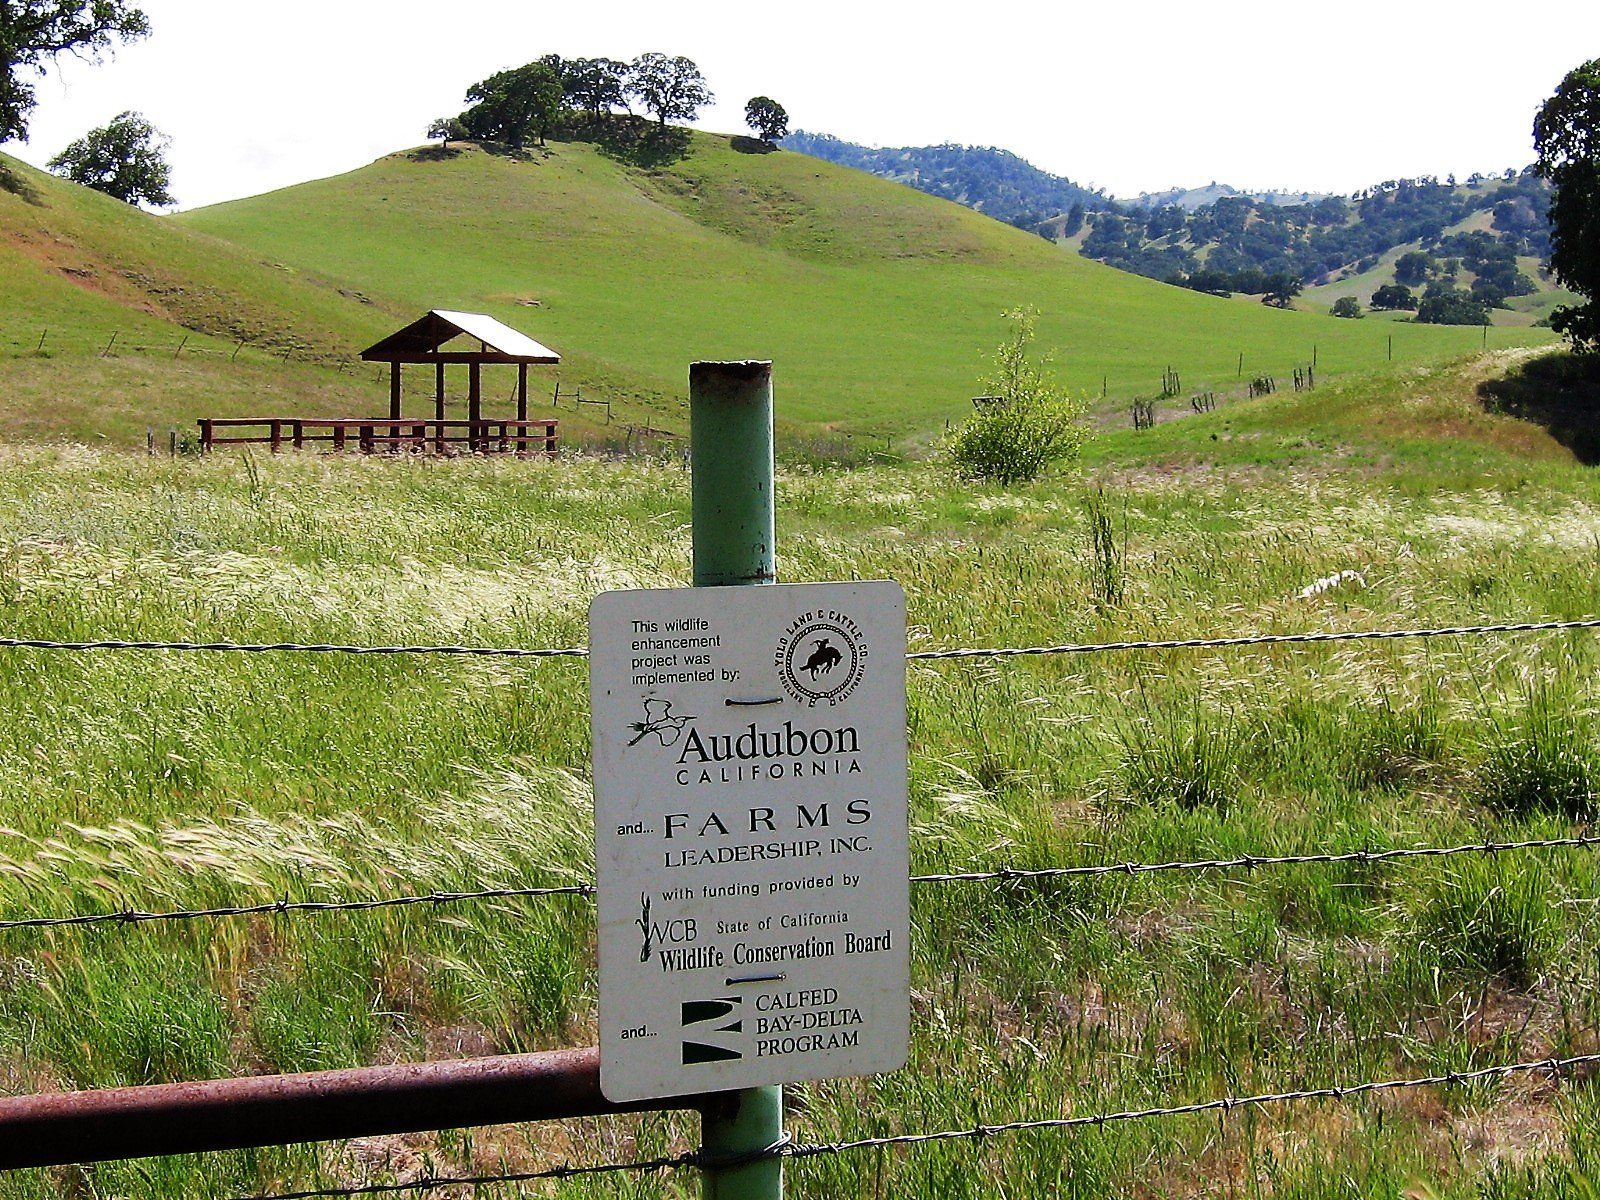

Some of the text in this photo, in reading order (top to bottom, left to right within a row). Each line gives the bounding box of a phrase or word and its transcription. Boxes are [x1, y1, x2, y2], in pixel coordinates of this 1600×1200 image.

[631, 619, 709, 633] This wildlife
[775, 638, 787, 666] YOLO
[786, 612, 813, 635] LAND
[829, 610, 863, 640] CATTLE
[631, 636, 720, 650] enhancement
[631, 654, 711, 669] project was
[631, 668, 740, 686] implemented by:
[839, 664, 865, 702] CALIFORNIA
[676, 721, 860, 764] Audubon
[677, 759, 861, 785] CALIFORNIA
[617, 799, 872, 839] and... FARMS
[664, 836, 872, 868] LEADERSHIP, INC.
[662, 873, 860, 901] with funding provided by
[635, 911, 848, 944] WCB State of California
[659, 930, 891, 972] Wildlife Conservation Board
[756, 987, 838, 1011] CALFED
[621, 1025, 657, 1039] and...
[756, 1008, 863, 1035] BAY-DELTA
[756, 1031, 859, 1057] PROGRAM
